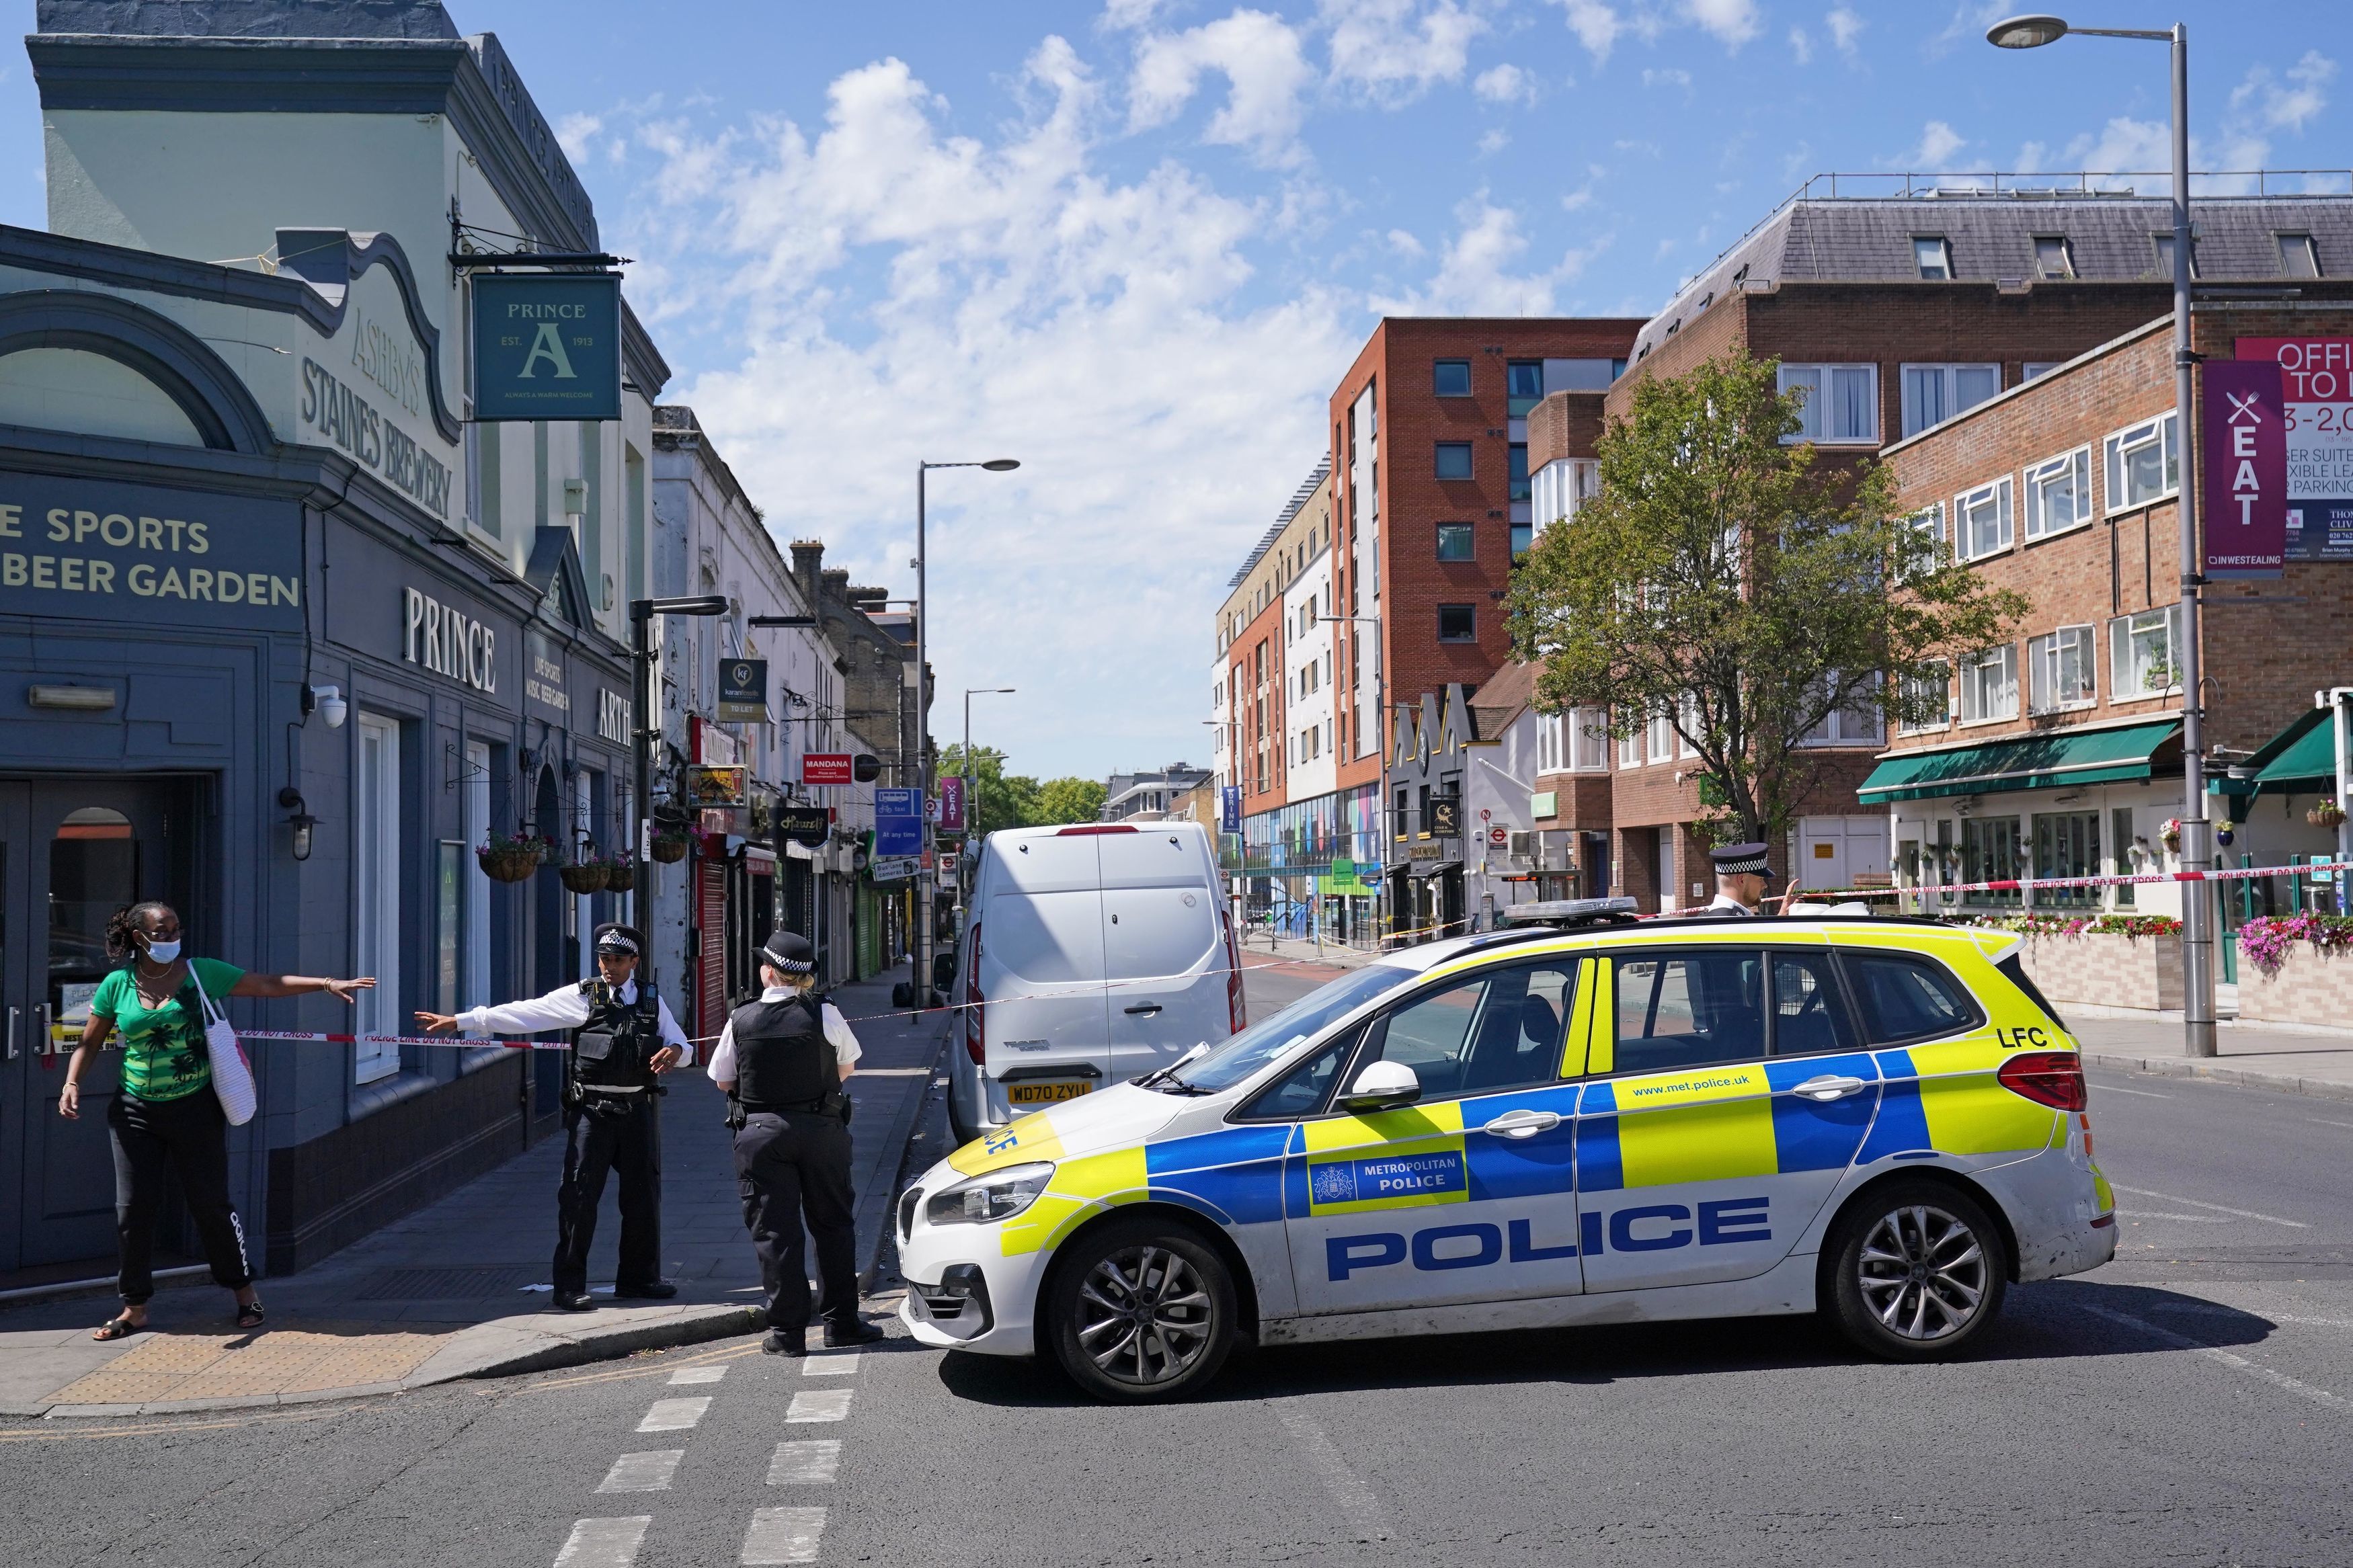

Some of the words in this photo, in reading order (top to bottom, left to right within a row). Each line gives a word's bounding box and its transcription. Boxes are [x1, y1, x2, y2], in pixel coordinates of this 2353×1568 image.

[508, 304, 586, 318] PRINCE
[502, 337, 522, 345] EST.
[573, 337, 593, 346] 1913
[517, 323, 577, 378] A
[2290, 371, 2337, 398] TO
[302, 356, 381, 469] STAINES
[383, 418, 452, 520] BREWERY
[2232, 426, 2260, 524] EAT
[47, 509, 208, 554] SPORTS
[3, 552, 115, 593] BEER
[128, 564, 298, 607] GARDEN
[405, 587, 496, 694] PRINCE
[534, 655, 544, 676] LIVE
[545, 660, 560, 684] SPORTS
[526, 678, 540, 700] MUSIC
[541, 684, 552, 704] BEER
[552, 689, 569, 710] GARDEN
[599, 688, 631, 747] ARTH
[1996, 1027, 2047, 1048] LFC
[1014, 1086, 1052, 1101] WD70
[1632, 1075, 1749, 1096] www.met.police.uk
[1365, 1158, 1455, 1175] METROPOLITAN
[1380, 1174, 1445, 1190] POLICE
[1326, 1197, 1772, 1282] POLICE
